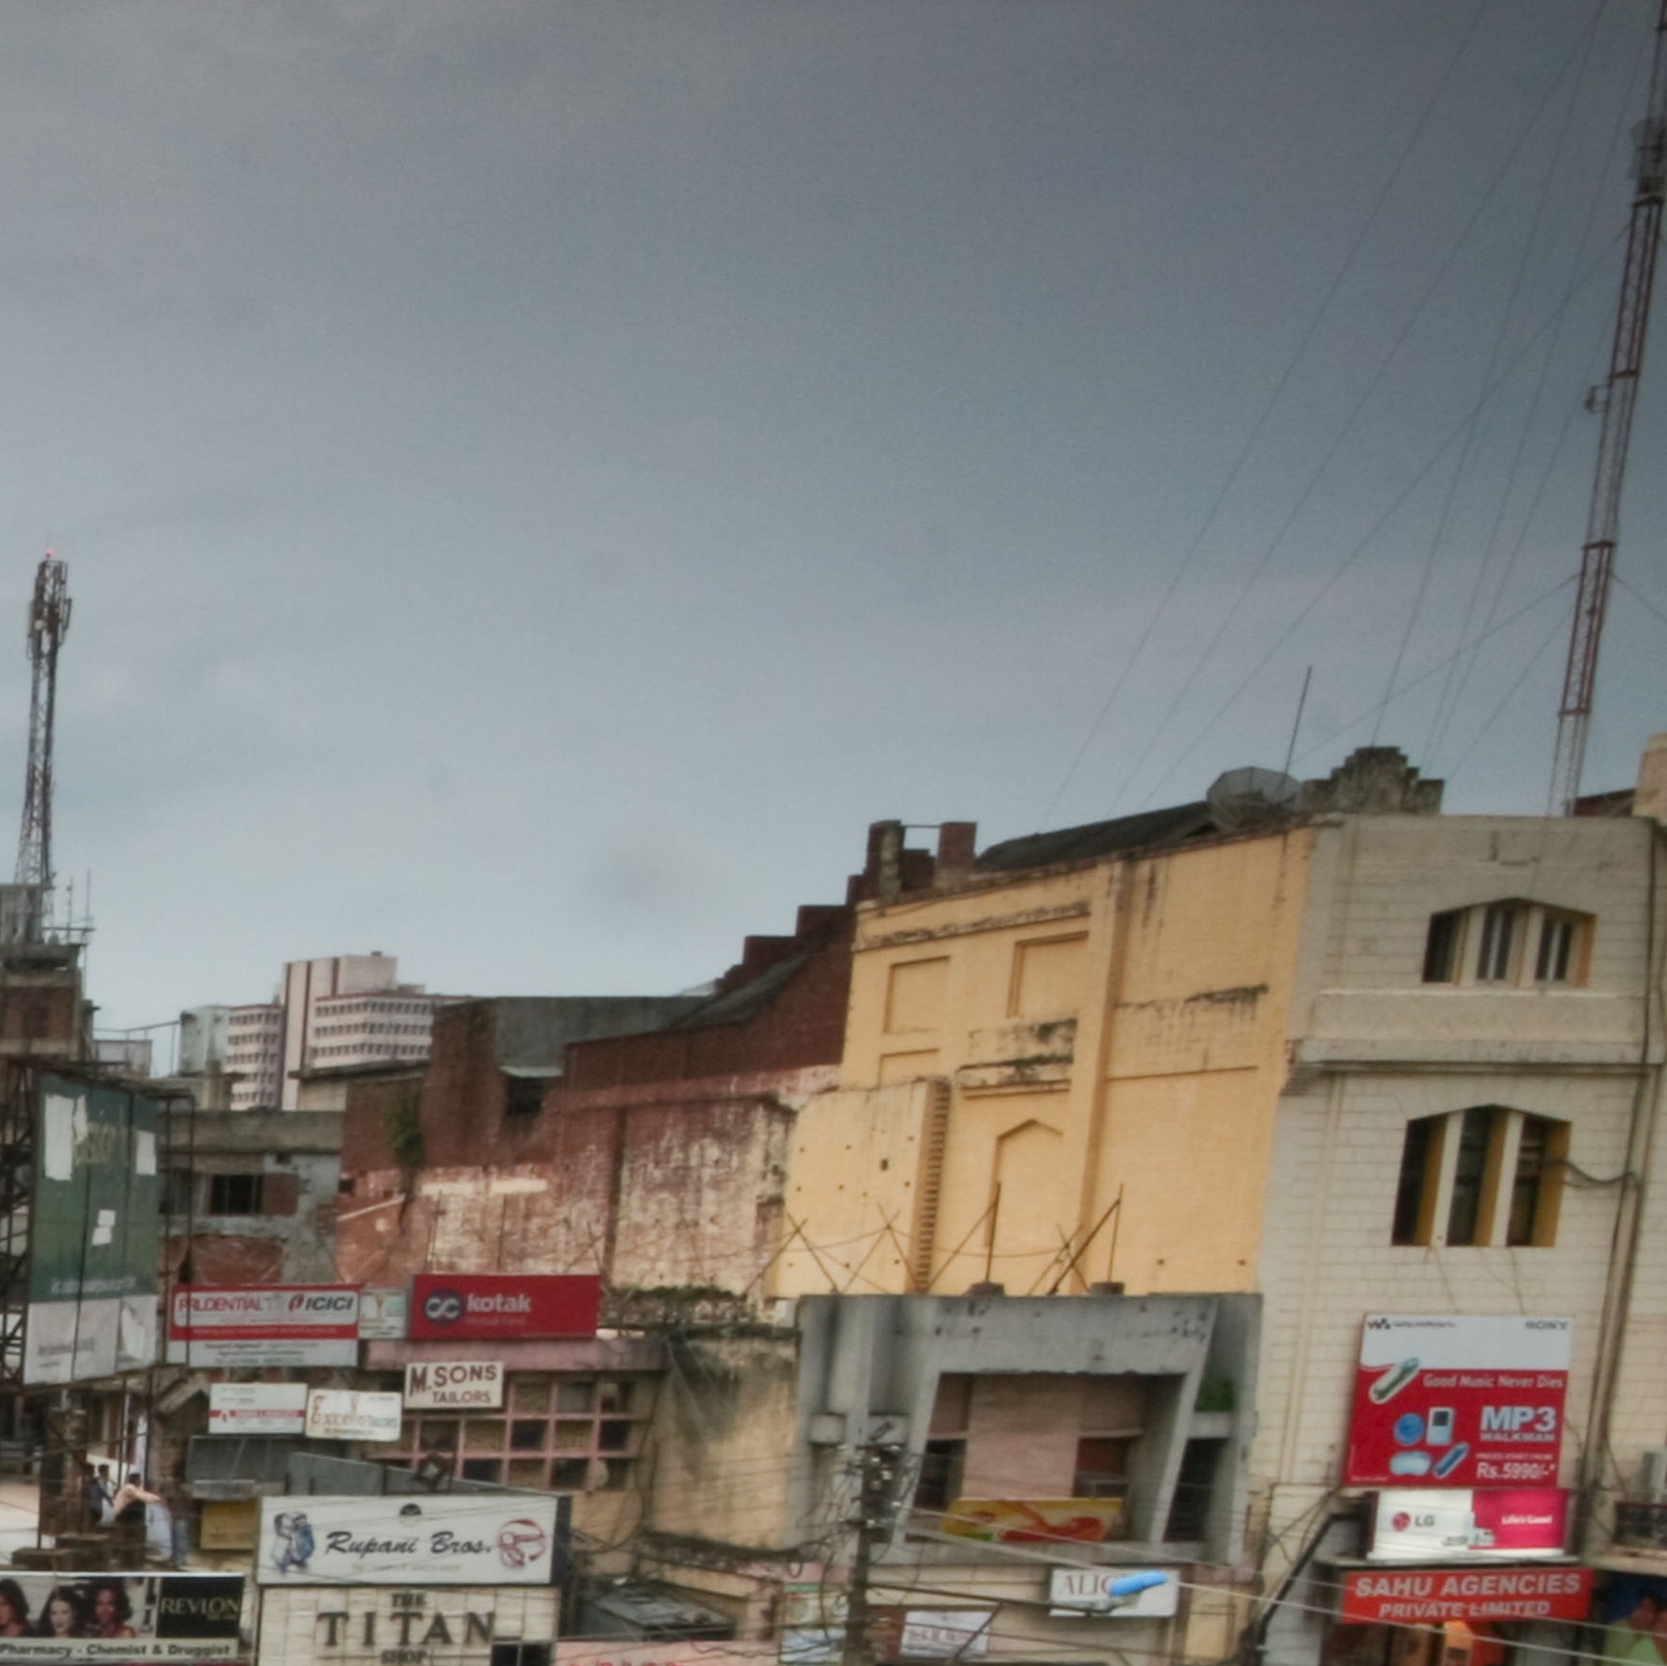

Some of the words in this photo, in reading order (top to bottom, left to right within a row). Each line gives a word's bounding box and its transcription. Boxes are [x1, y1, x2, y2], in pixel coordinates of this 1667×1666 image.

[305, 1297, 354, 1312] ICICI
[467, 1293, 531, 1312] kotak
[1524, 1320, 1568, 1330] SONY
[1423, 1374, 1457, 1388] Good
[1459, 1374, 1494, 1388] Music
[1499, 1374, 1534, 1388] Never
[1536, 1374, 1564, 1388] Dies
[432, 1391, 491, 1404] TAILORS
[1480, 1405, 1556, 1431] MP3
[1480, 1432, 1554, 1442] WALKMAN
[1414, 1515, 1435, 1527] LG
[326, 1531, 419, 1558] Rupani
[431, 1531, 492, 1553] Bros.
[1355, 1577, 1433, 1597] SAHU
[1440, 1574, 1581, 1596] AGENCIES
[161, 1597, 239, 1614] REVLON
[1379, 1602, 1463, 1618] PRIVATE
[1469, 1600, 1550, 1617] LIMITED
[317, 1611, 495, 1647] TITAN
[0, 1644, 73, 1660] Pharmacy
[87, 1644, 147, 1655] Chemist
[152, 1644, 162, 1655] &
[381, 1650, 427, 1664] SHOP
